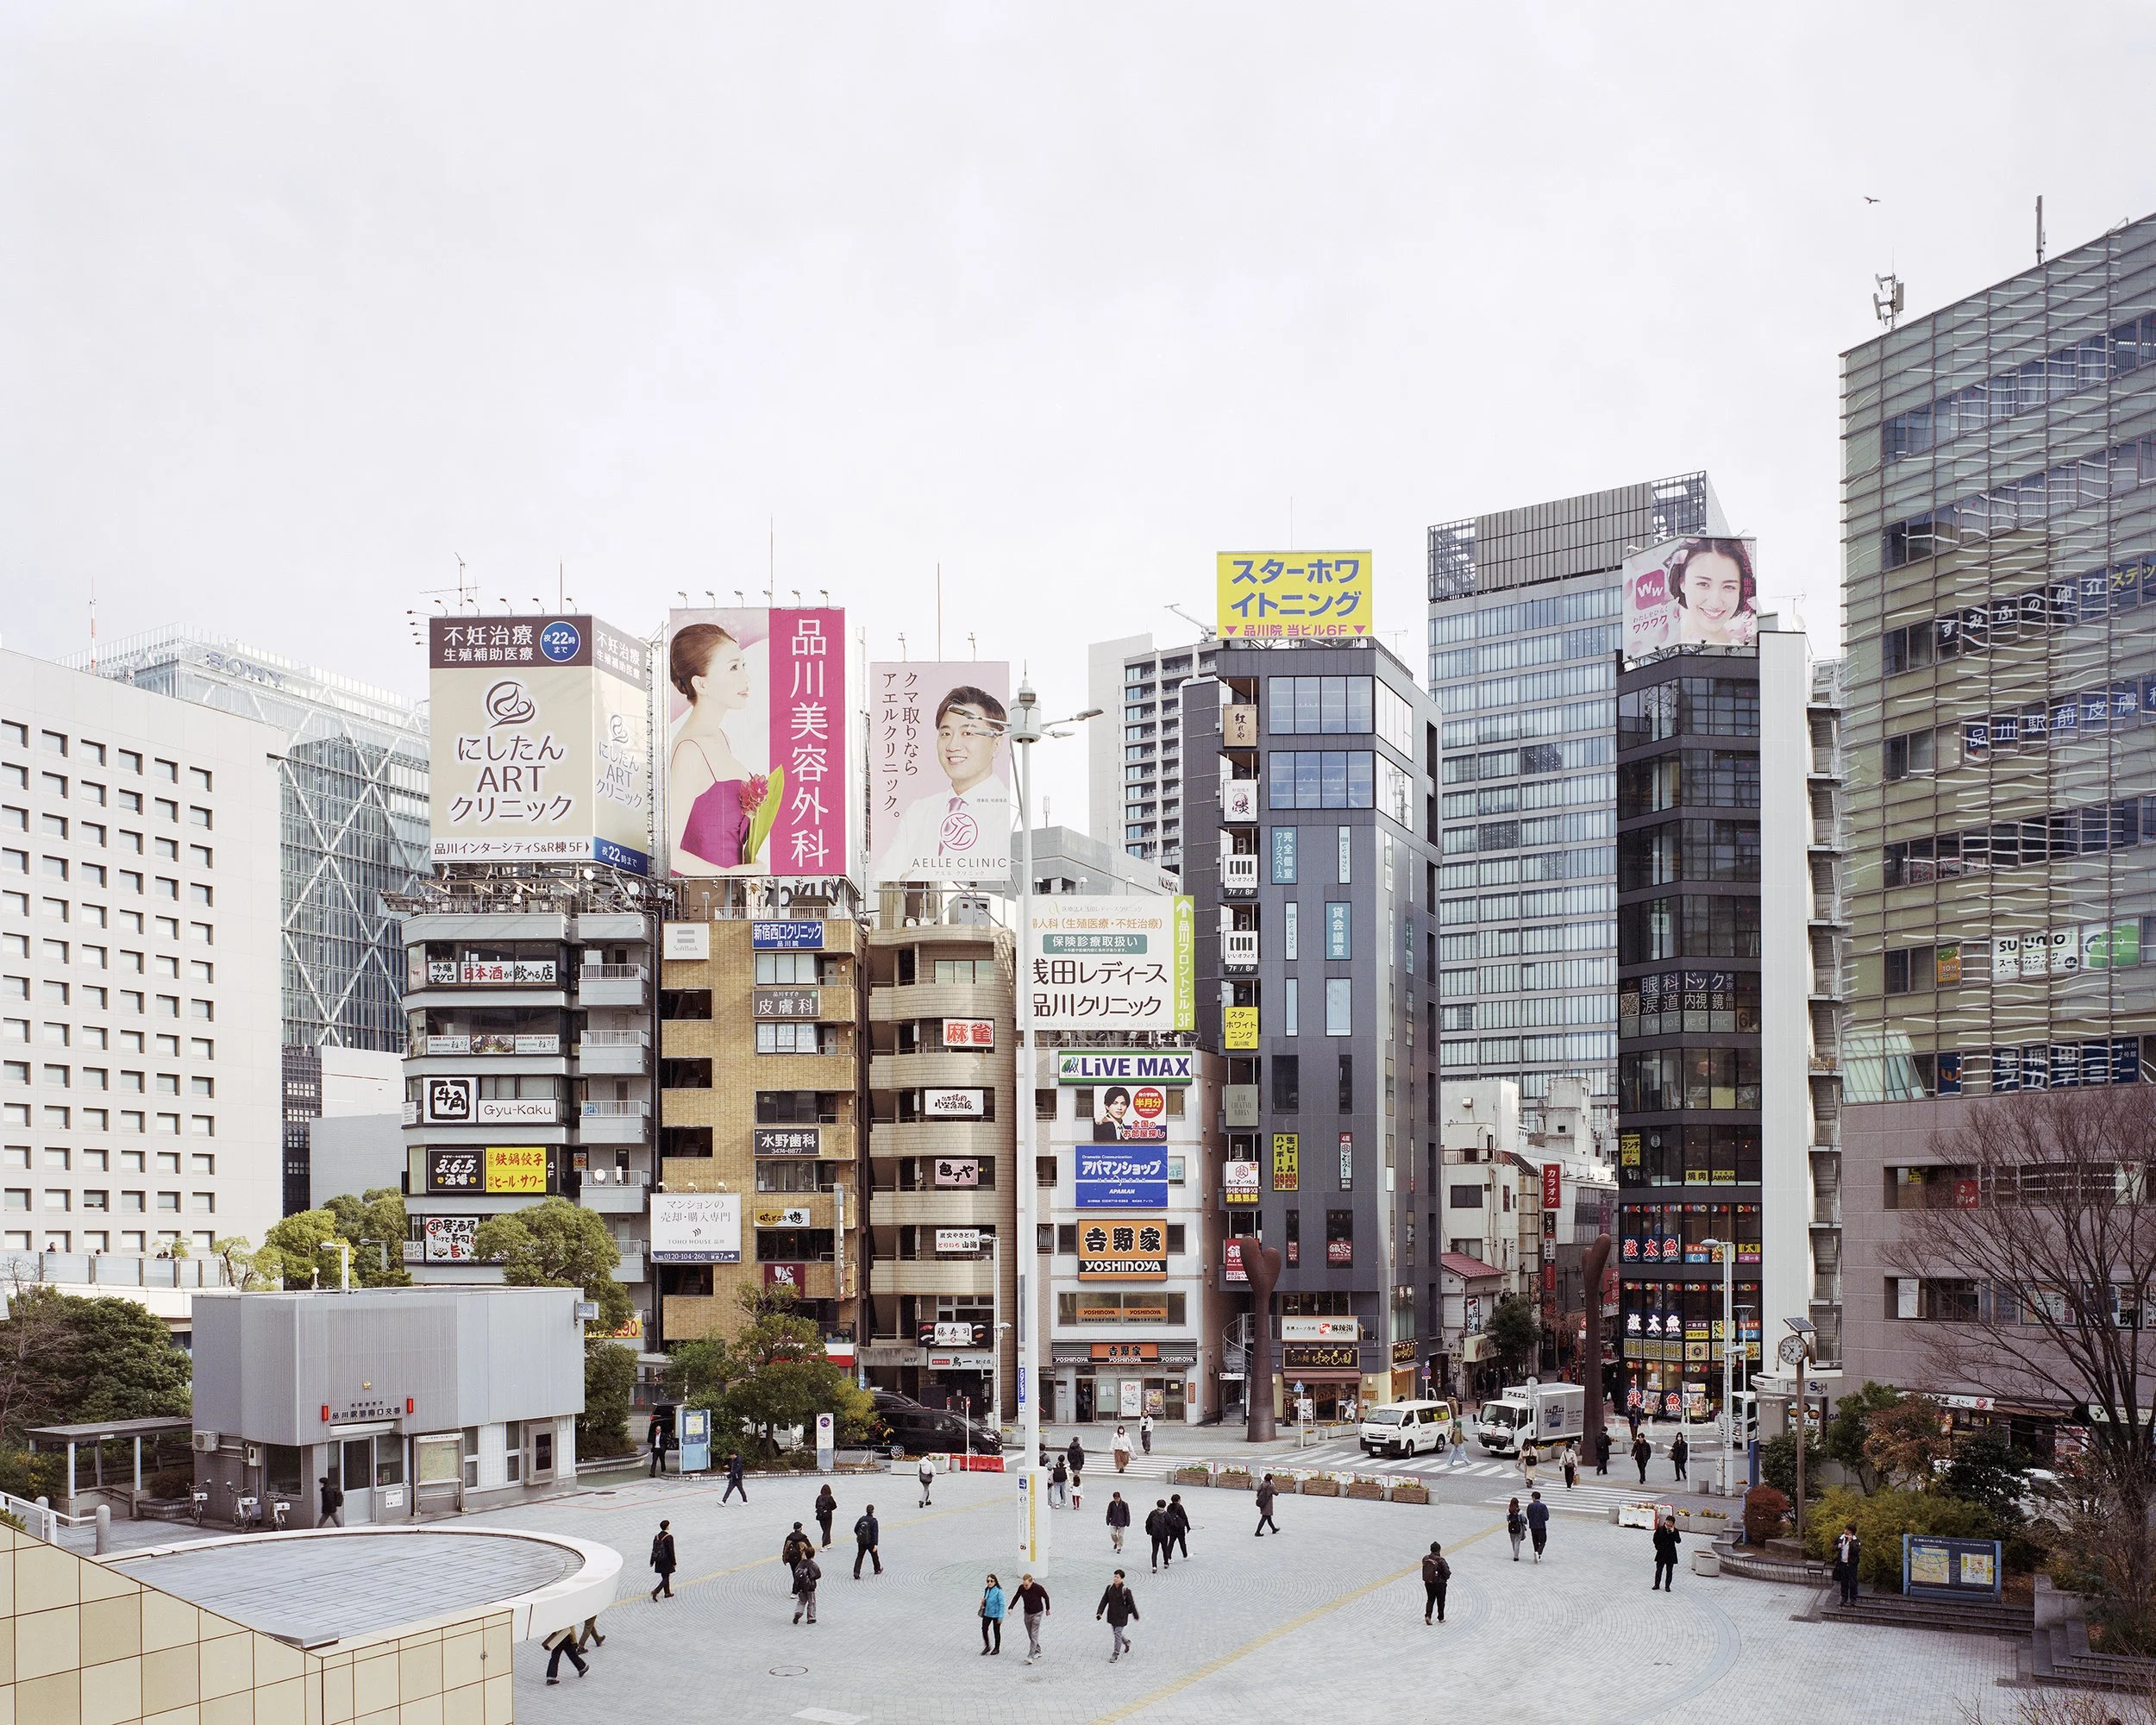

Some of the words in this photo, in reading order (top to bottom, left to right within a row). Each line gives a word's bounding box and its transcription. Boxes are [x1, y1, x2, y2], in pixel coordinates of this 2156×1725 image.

[1232, 559, 1359, 585] スターホワ
[1231, 591, 1362, 618] イトニング
[1244, 624, 1282, 637] 品川院
[1288, 624, 1347, 637] 当ビル6F
[1633, 615, 1667, 634] ワクワク
[443, 624, 534, 646] 不妊治療
[543, 631, 576, 645] 夜22時
[443, 646, 534, 662] 生殖補助医療
[595, 628, 640, 667] 不妊治療
[205, 651, 286, 688] SONY
[596, 649, 640, 681] 生殖補助医療
[903, 672, 920, 775] クマ取りなら
[457, 735, 563, 762] にしたん
[788, 618, 829, 868] 品川美容外科
[882, 673, 899, 818] アエルクリニック。
[599, 739, 639, 773] にしたん
[477, 765, 545, 794] ART
[606, 763, 633, 785] ART
[596, 780, 643, 810] クリニック
[449, 794, 573, 823] クリニック
[569, 841, 583, 853] 5F
[1283, 832, 1293, 879] 完全個室
[601, 844, 637, 869] 夜22時まで
[912, 858, 951, 868] AELLE
[957, 858, 1006, 868] CLINIC
[754, 925, 822, 941] 新宿西口クリニック
[1332, 906, 1344, 956] 貸会議室
[1053, 936, 1138, 947] 保険診療取扱い
[464, 964, 554, 982] 日本酒が飲める店
[1178, 920, 1190, 1010] 品川フロントビル
[431, 972, 454, 982] マグロ
[1642, 972, 1724, 994] 眼科ドック
[758, 999, 814, 1015] 皮膚科
[1033, 994, 1162, 1017] 品川クリニック
[1642, 993, 1724, 1013] 涙道内視鏡
[1178, 1013, 1190, 1027] 3F
[1699, 1016, 1727, 1026] Clinic
[947, 1022, 993, 1044] 麻雀
[1138, 1058, 1189, 1076] MAX
[1999, 1048, 2076, 1069] 早稲田
[436, 1087, 466, 1113] 牛角
[1136, 1098, 1162, 1107] 半月分
[484, 1104, 552, 1117] Gyu-Kaku
[761, 1133, 816, 1147] 水野歯科
[1123, 1129, 1165, 1138] お部屋探し
[495, 1152, 543, 1166] 鉄鍋餃子
[1286, 1137, 1294, 1172] 生ビール
[1082, 1160, 1161, 1176] アパマンショップ
[445, 1174, 468, 1185] 酒場
[495, 1175, 543, 1189] ビール・サワー
[1547, 1170, 1556, 1204] カラオケ
[661, 1212, 730, 1222] 売却・購入専門
[788, 1211, 804, 1224] 遊
[430, 1222, 441, 1231] 3F
[443, 1220, 475, 1233] 居酒屋
[1085, 1226, 1162, 1253] 吉野家
[1329, 1244, 1351, 1253] 銀だこ
[1085, 1261, 1161, 1272] YOSHINOYA
[1332, 1324, 1353, 1333] 麻辣湯
[1109, 1346, 1141, 1356] 吉野家
[332, 1407, 401, 1420] 品川駅港南口交番
